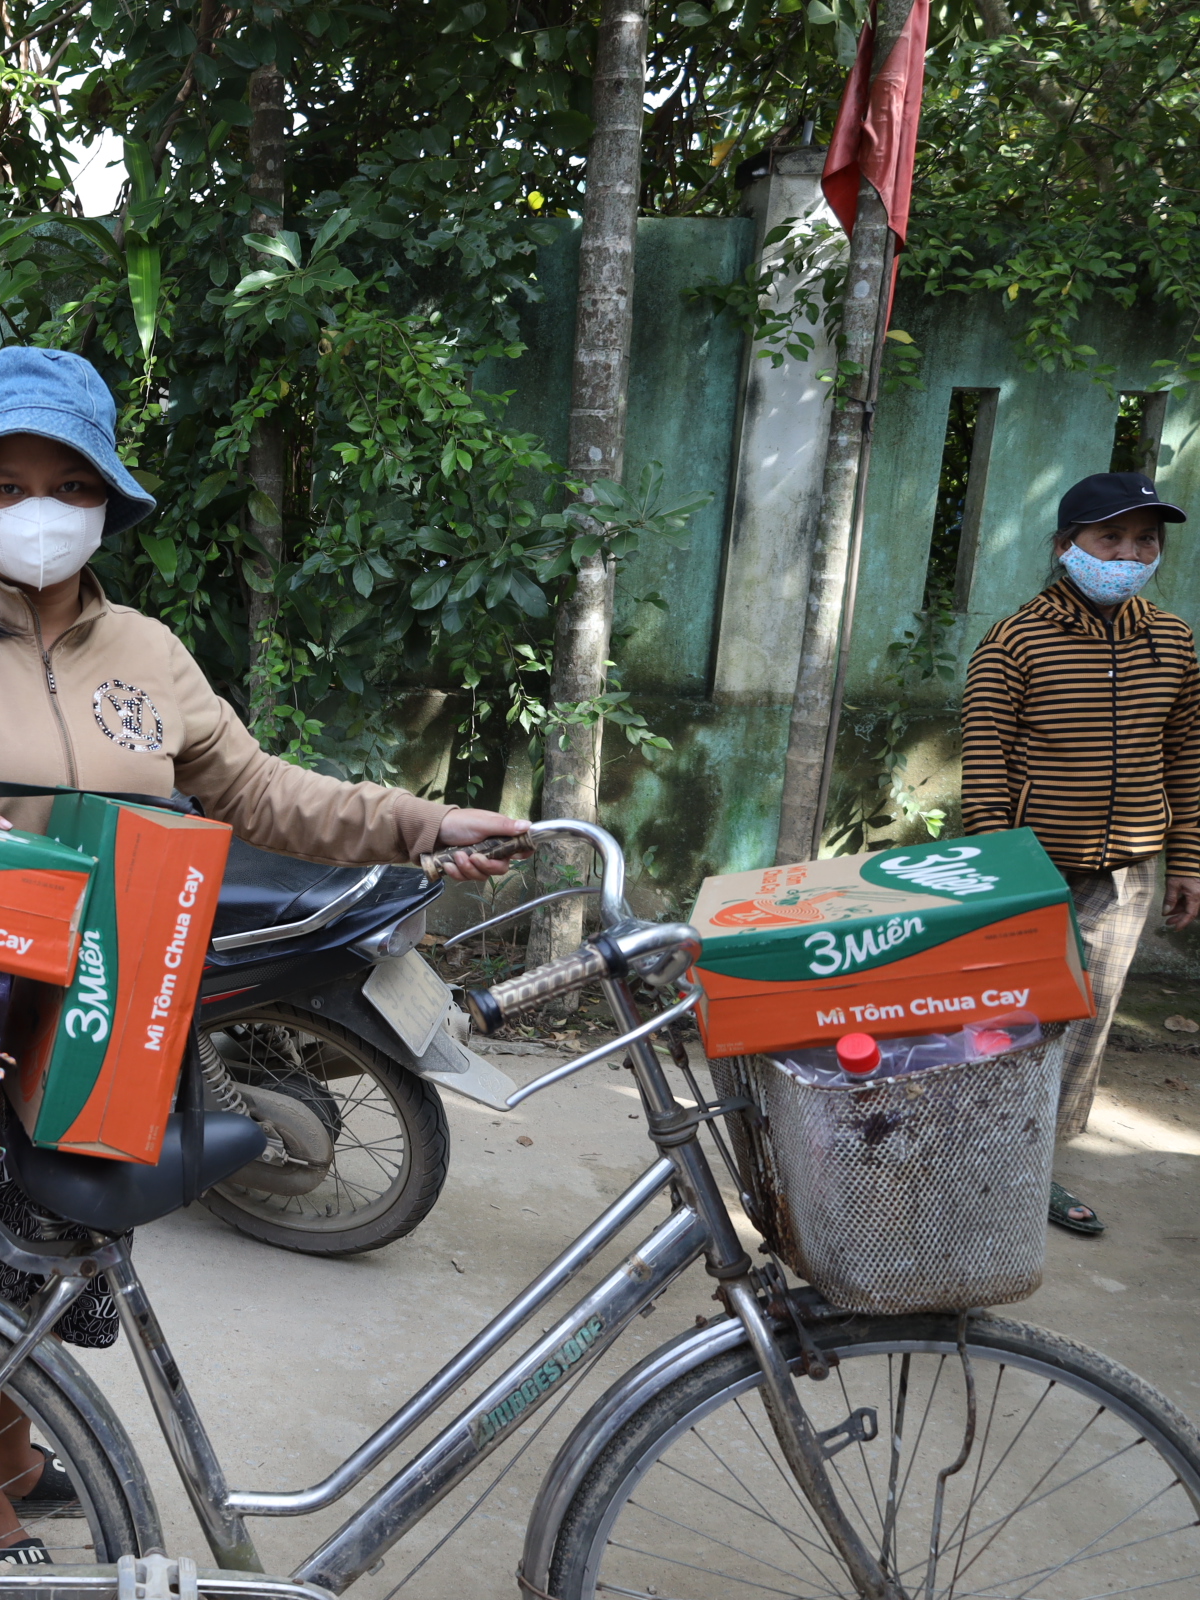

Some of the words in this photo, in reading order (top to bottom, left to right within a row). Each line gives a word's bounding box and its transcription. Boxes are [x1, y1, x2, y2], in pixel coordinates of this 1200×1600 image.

[178, 866, 205, 908] Cay
[164, 912, 192, 969] Chua
[152, 973, 178, 1020] Tôm
[817, 1008, 846, 1027] Mì
[849, 1003, 905, 1022] Tôm
[909, 995, 977, 1016] Chua
[981, 988, 1030, 1008] Cay
[144, 1024, 166, 1051] Mì
